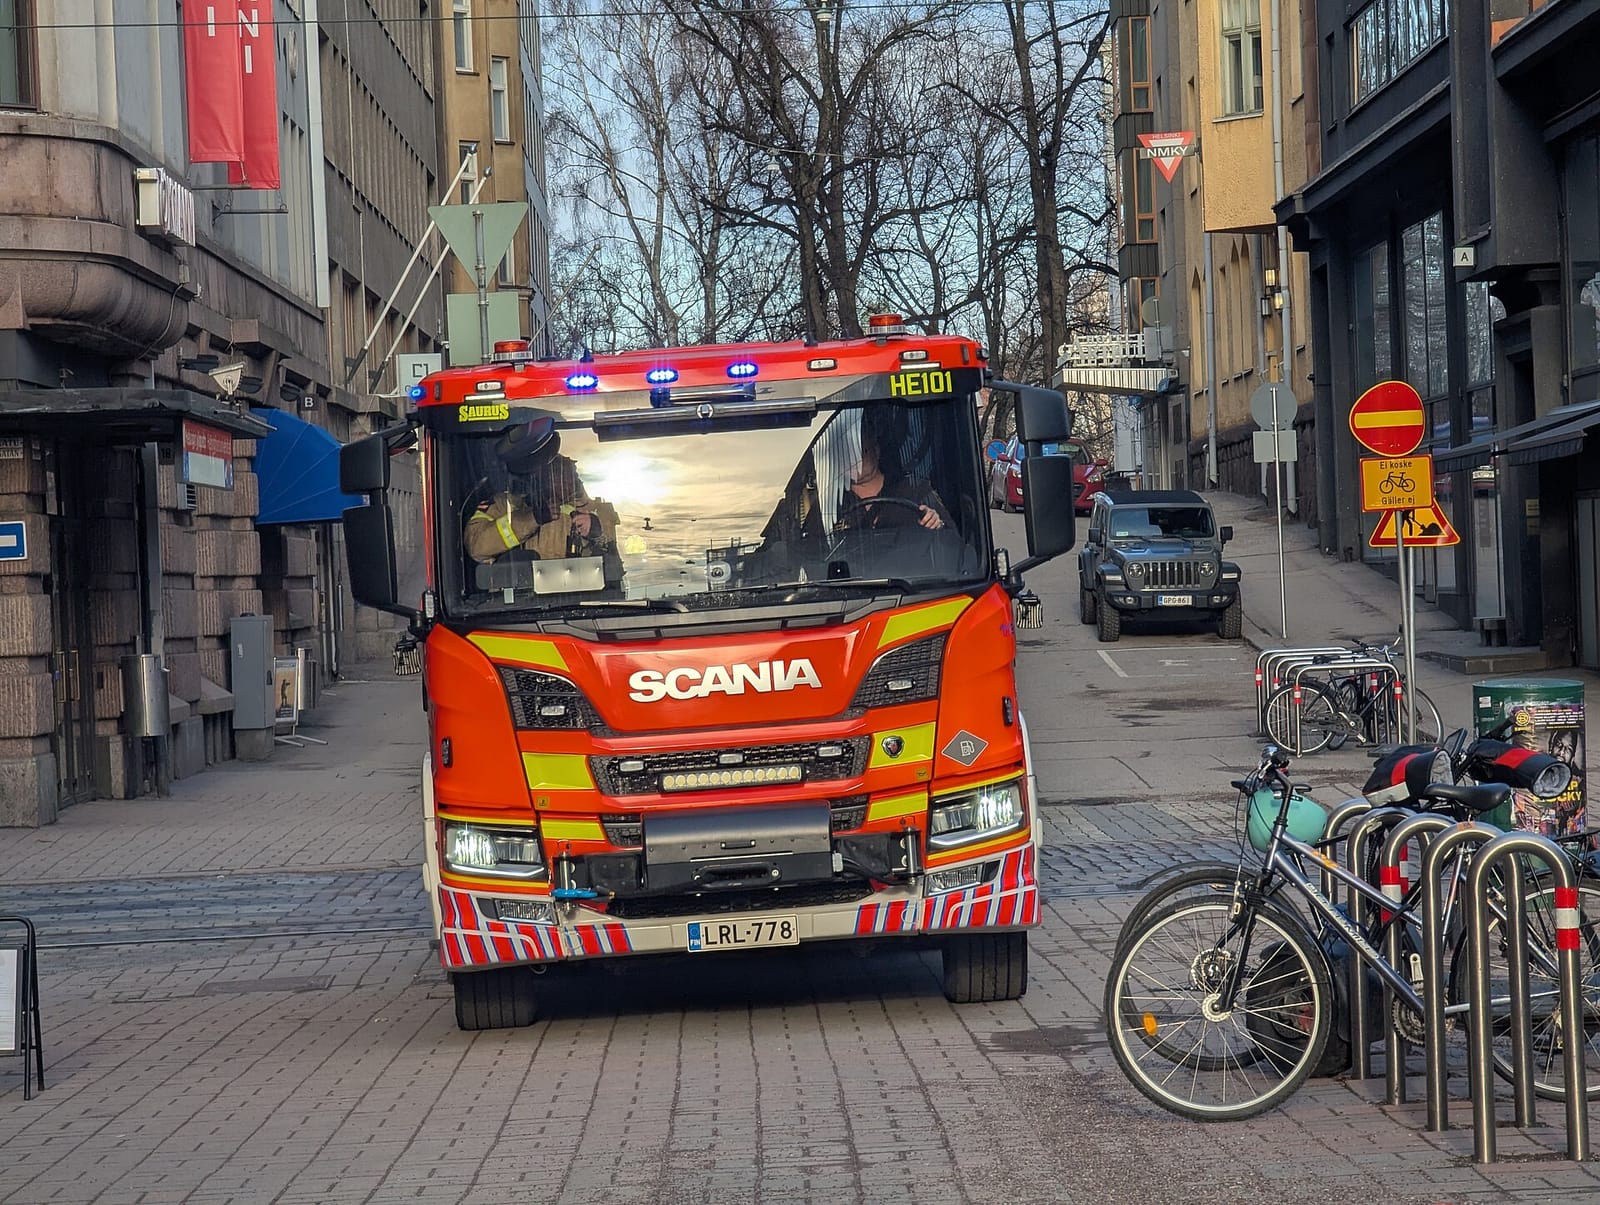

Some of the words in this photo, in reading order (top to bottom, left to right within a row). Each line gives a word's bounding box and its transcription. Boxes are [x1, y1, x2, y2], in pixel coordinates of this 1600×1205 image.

[1147, 146, 1188, 158] NMKY
[1461, 252, 1469, 262] A
[890, 371, 953, 396] HE101
[305, 397, 314, 408] B
[459, 403, 510, 423] SAURUS
[1389, 460, 1413, 470] koske
[1381, 496, 1405, 505] Gäller
[1408, 495, 1415, 505] ej
[628, 658, 823, 703] SCANIA
[704, 920, 793, 945] LRL-778
